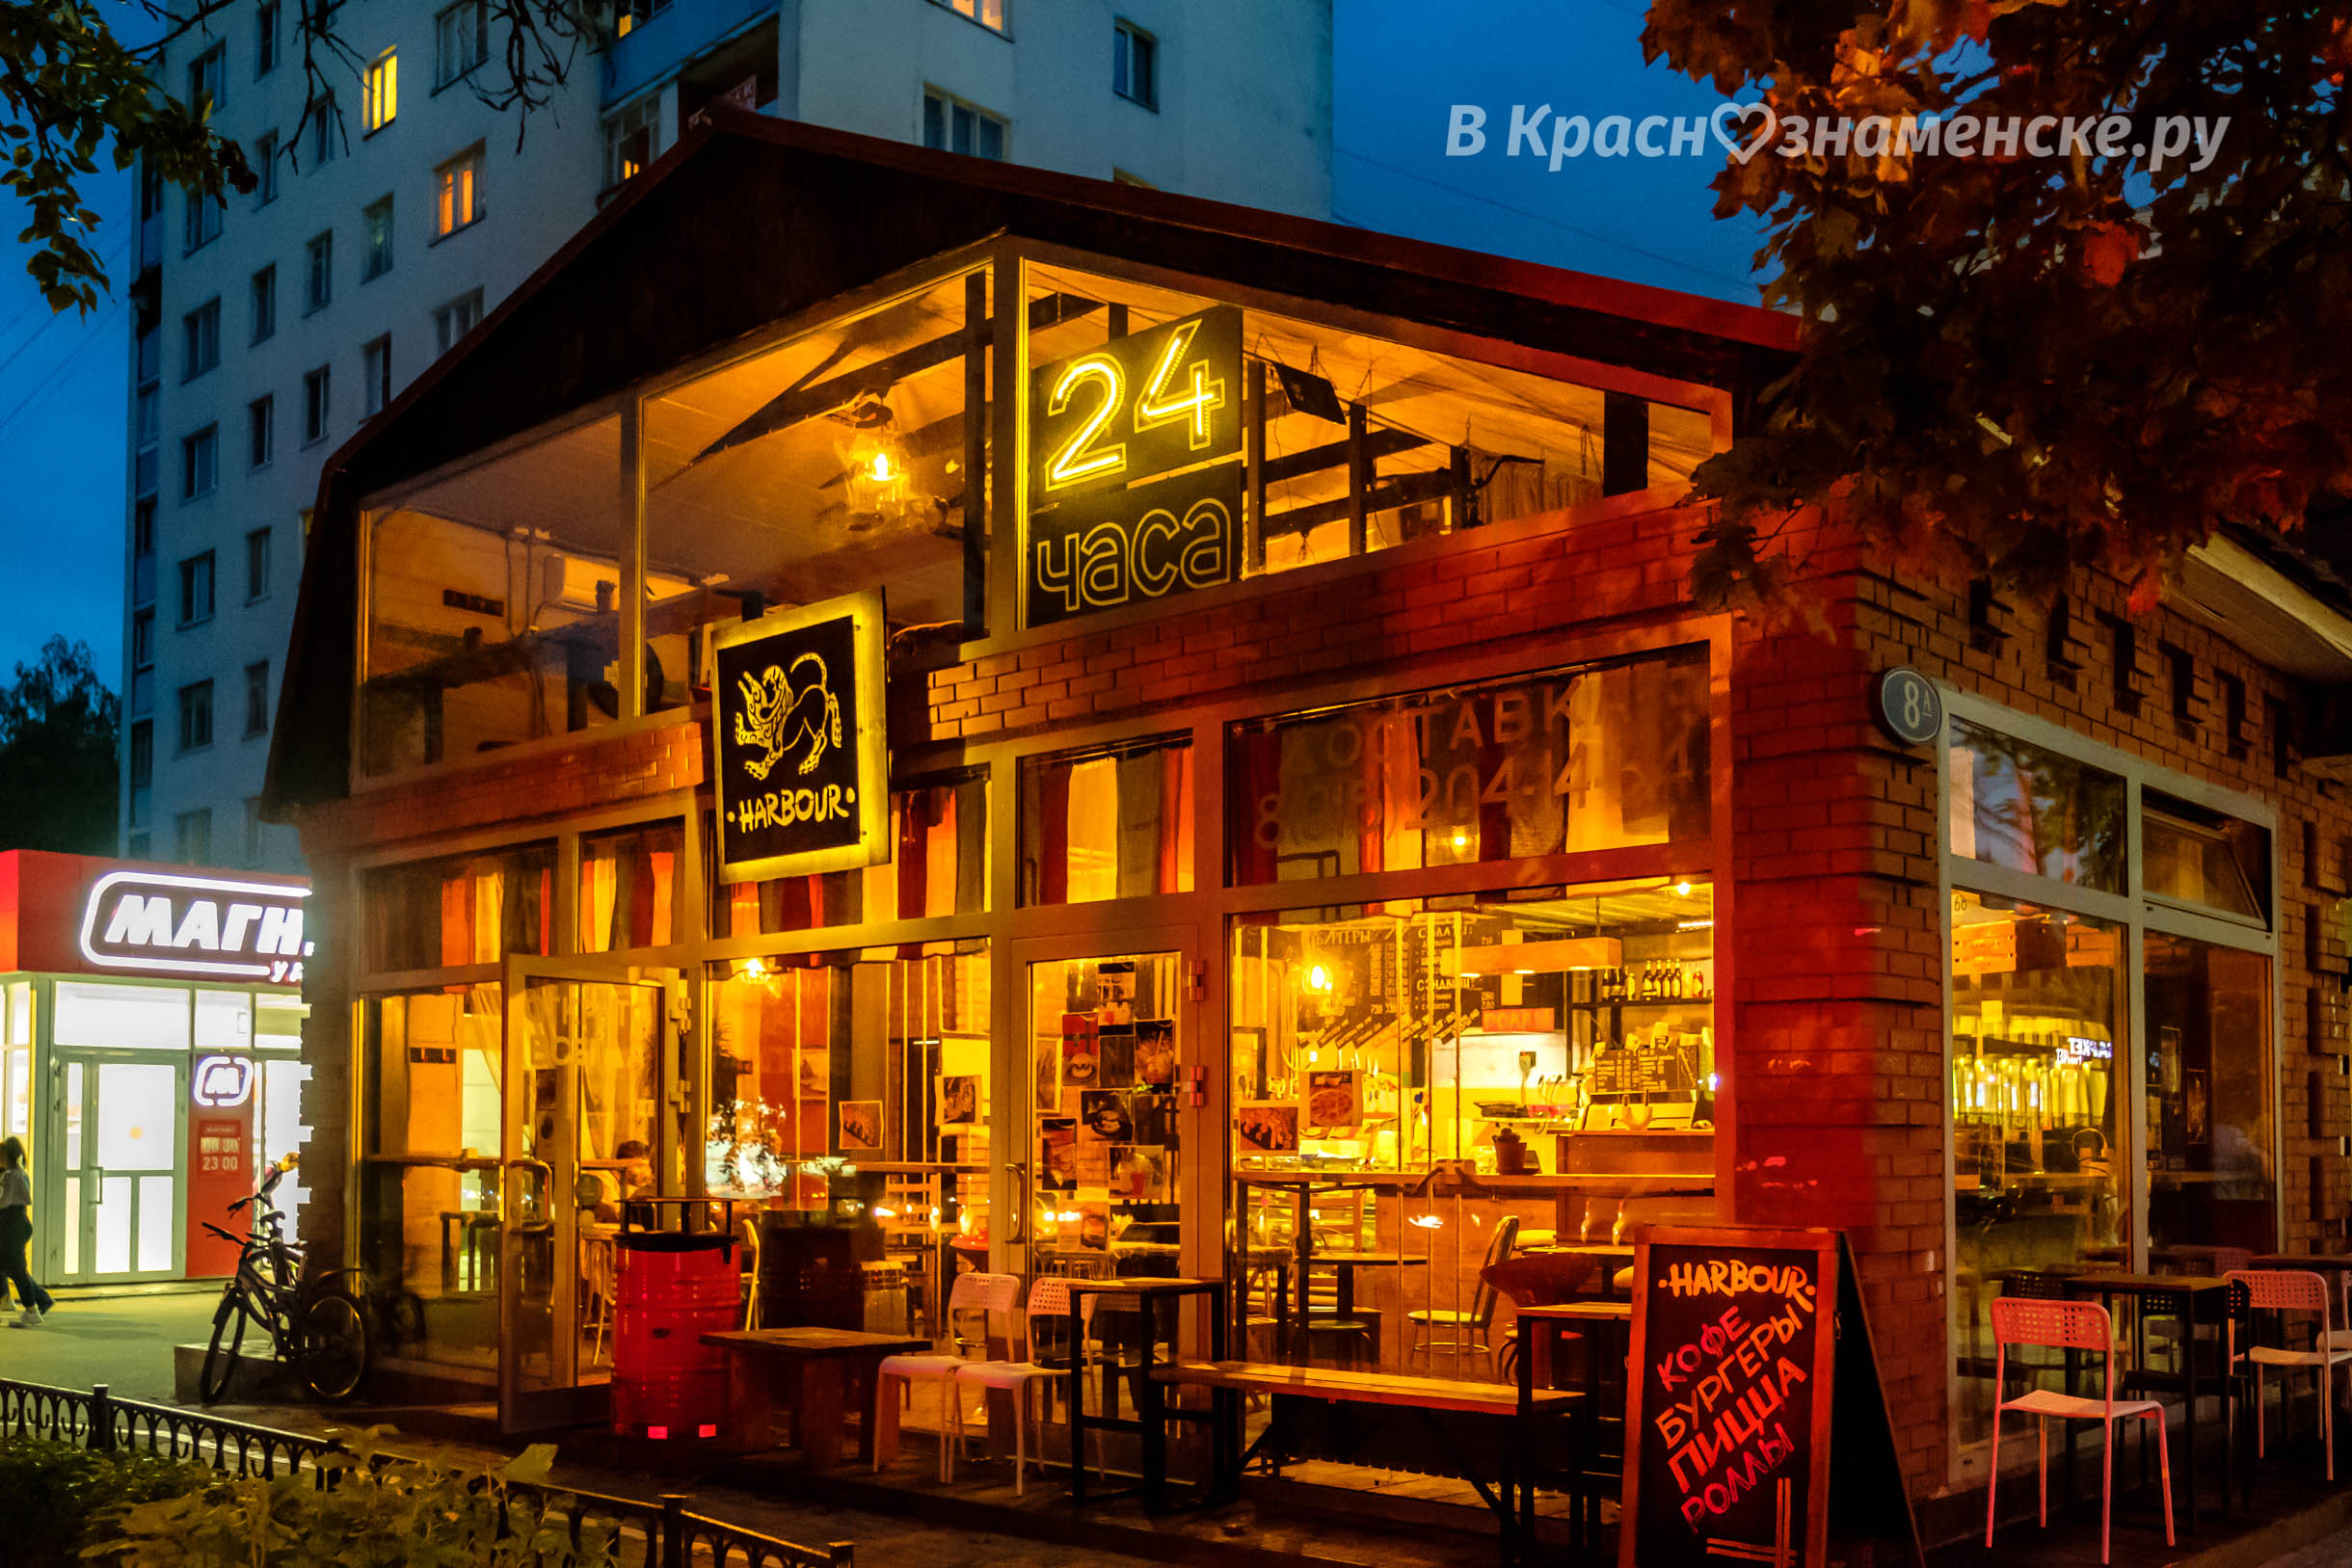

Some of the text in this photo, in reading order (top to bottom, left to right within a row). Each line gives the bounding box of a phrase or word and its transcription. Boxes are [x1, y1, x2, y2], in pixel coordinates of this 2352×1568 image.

[1045, 319, 1225, 492] 24
[1036, 497, 1232, 612] часа
[738, 784, 850, 833] HARBOUR
[104, 894, 308, 956] МАГН
[202, 1156, 219, 1171] 23
[1669, 1259, 1814, 1313] HARBOUR
[1654, 1303, 1803, 1449] БУРГЕРЫ
[1657, 1306, 1751, 1392] КОФЕ
[1668, 1356, 1807, 1494] ПИЦЦА
[1680, 1422, 1795, 1534] РОЛЛЫ
